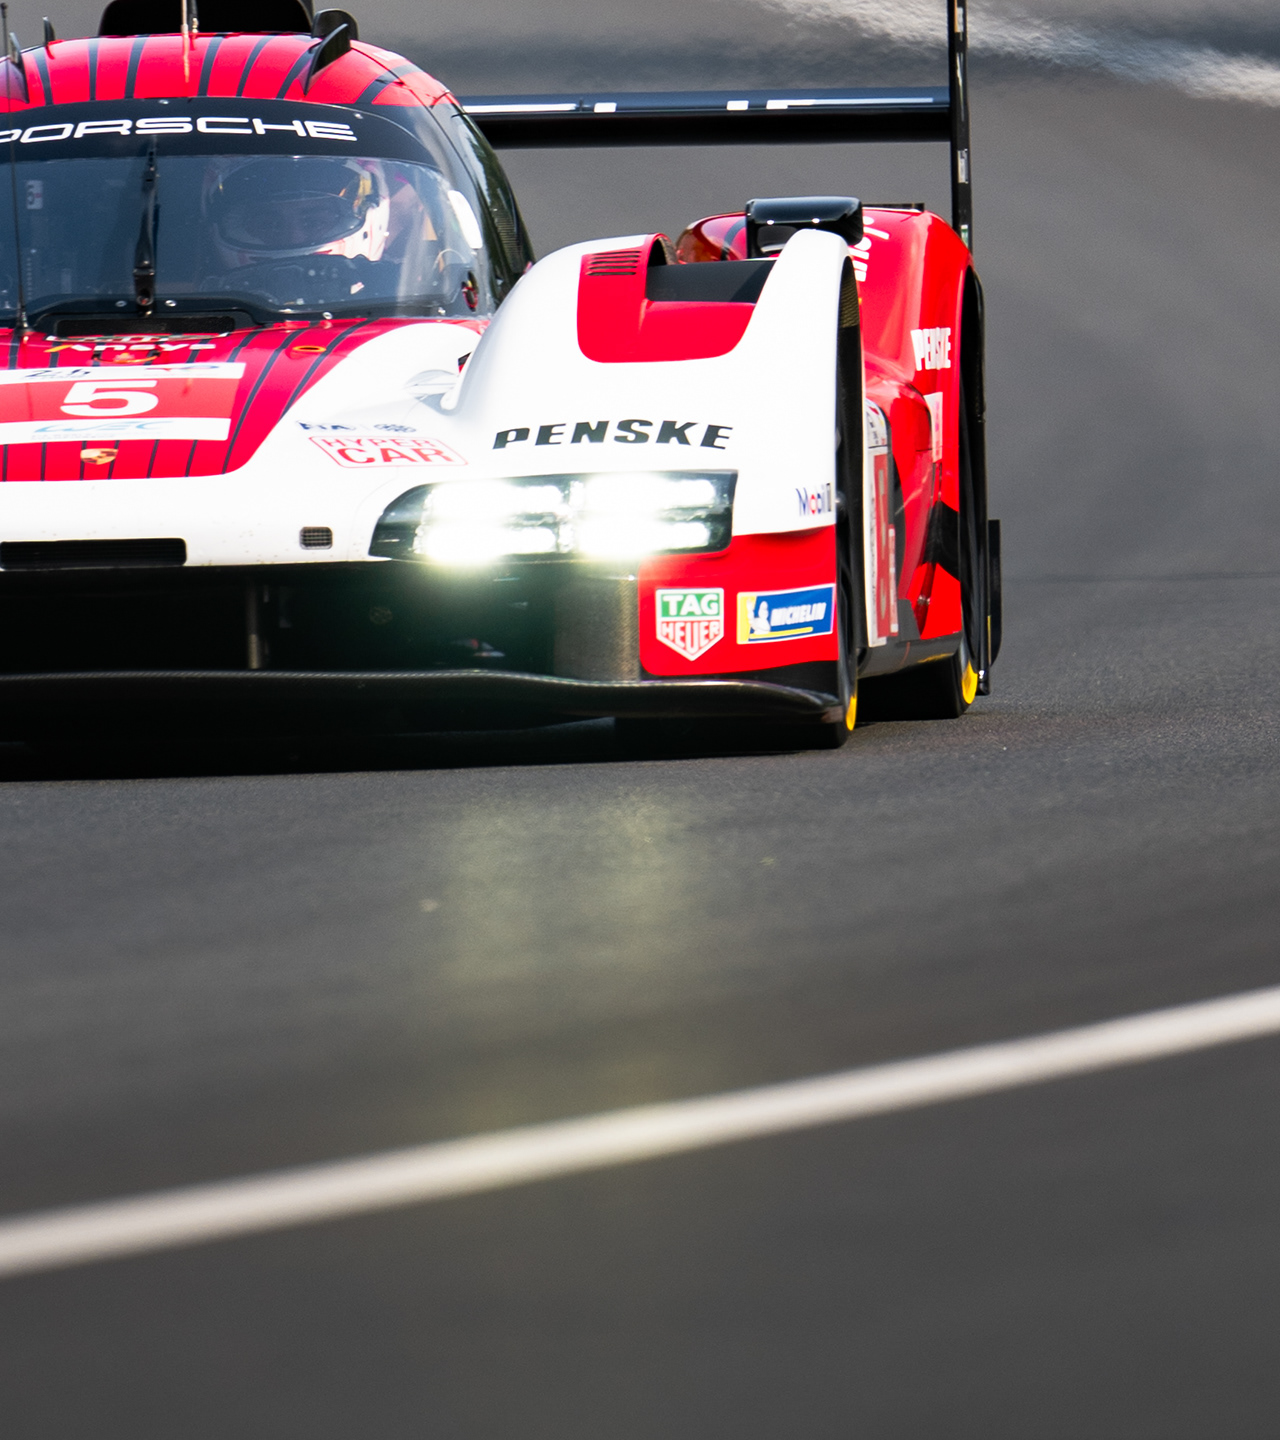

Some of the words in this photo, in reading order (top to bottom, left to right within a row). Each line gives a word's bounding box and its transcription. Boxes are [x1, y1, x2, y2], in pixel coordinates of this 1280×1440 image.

[910, 327, 951, 372] PENSKE
[60, 380, 159, 417] 5
[320, 438, 437, 448] HYPER
[492, 419, 733, 450] PENSKE
[336, 447, 454, 464] CAR
[662, 593, 719, 616] TAG
[770, 602, 827, 627] MICHELIN
[661, 620, 720, 654] HEUER
